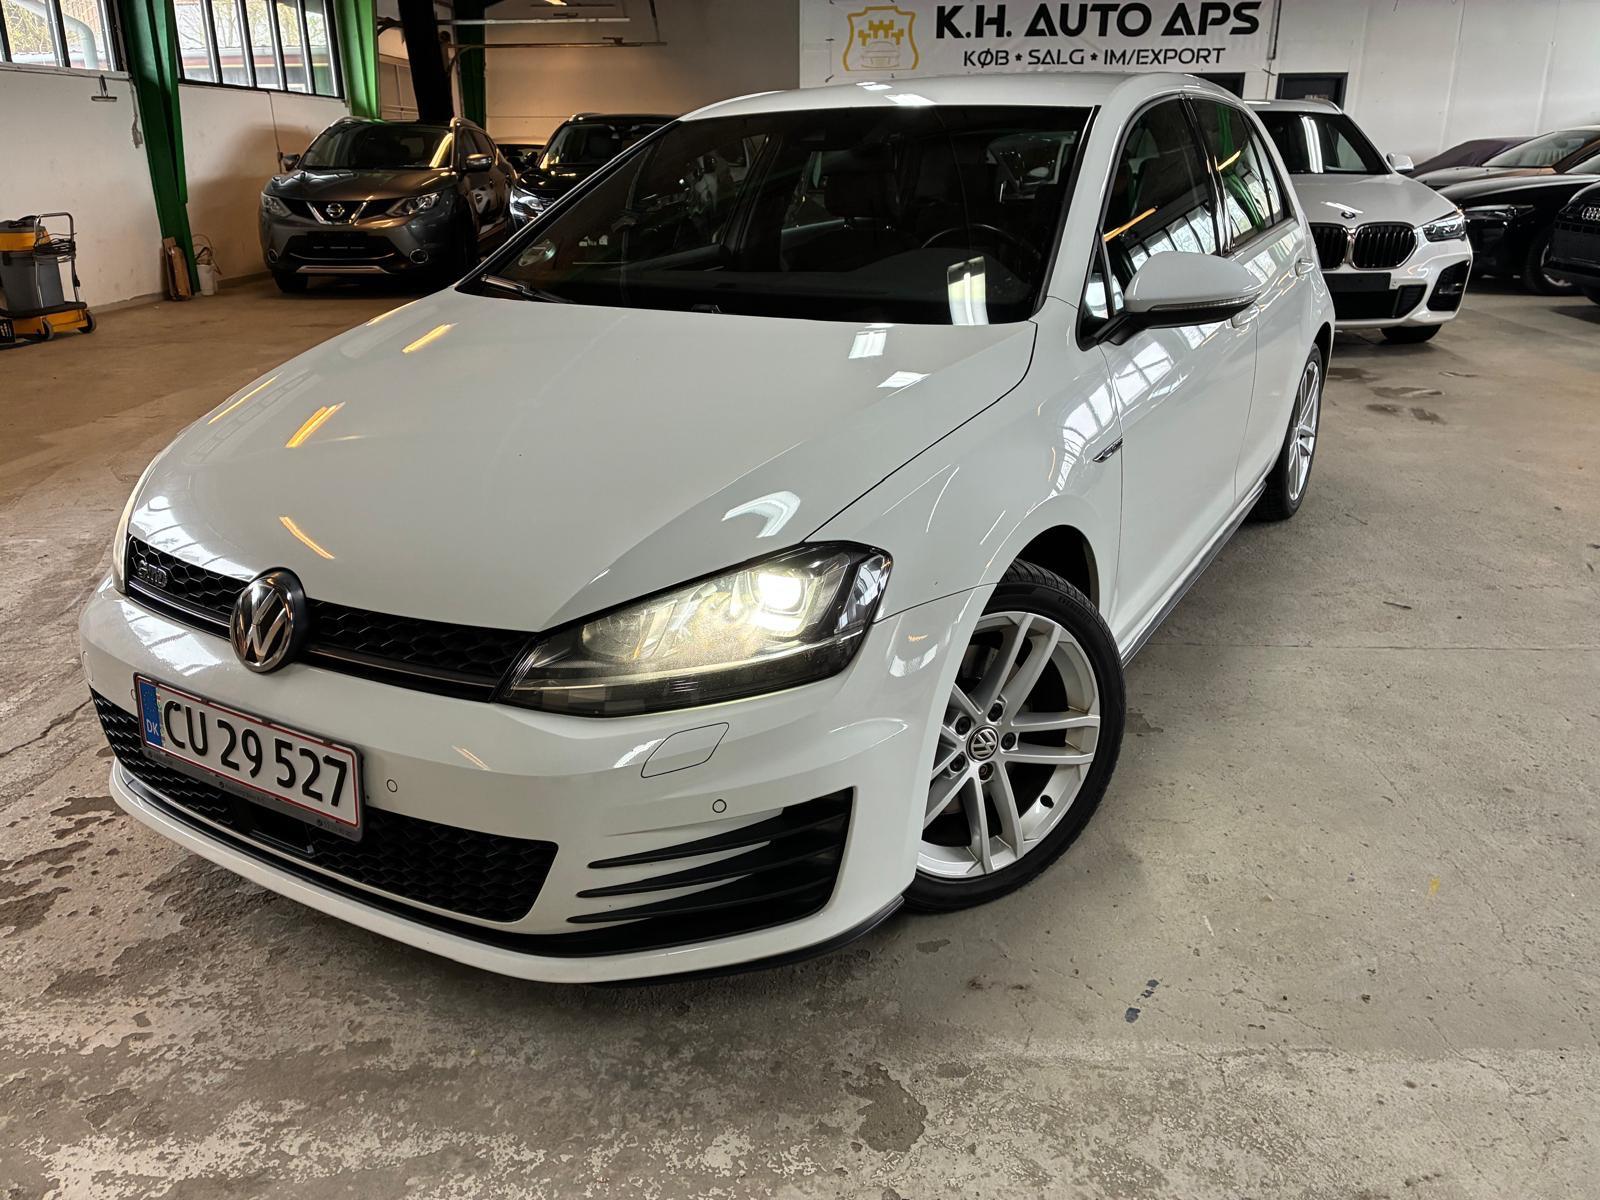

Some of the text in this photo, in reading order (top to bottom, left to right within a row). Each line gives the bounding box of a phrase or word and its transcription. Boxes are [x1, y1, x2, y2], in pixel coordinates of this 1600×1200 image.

[936, 1, 1262, 39] K.H. AUTO APS
[964, 47, 1226, 69] KØB SALG IM/EXPORT
[146, 718, 160, 737] DK
[163, 700, 348, 808] CU 29 527
